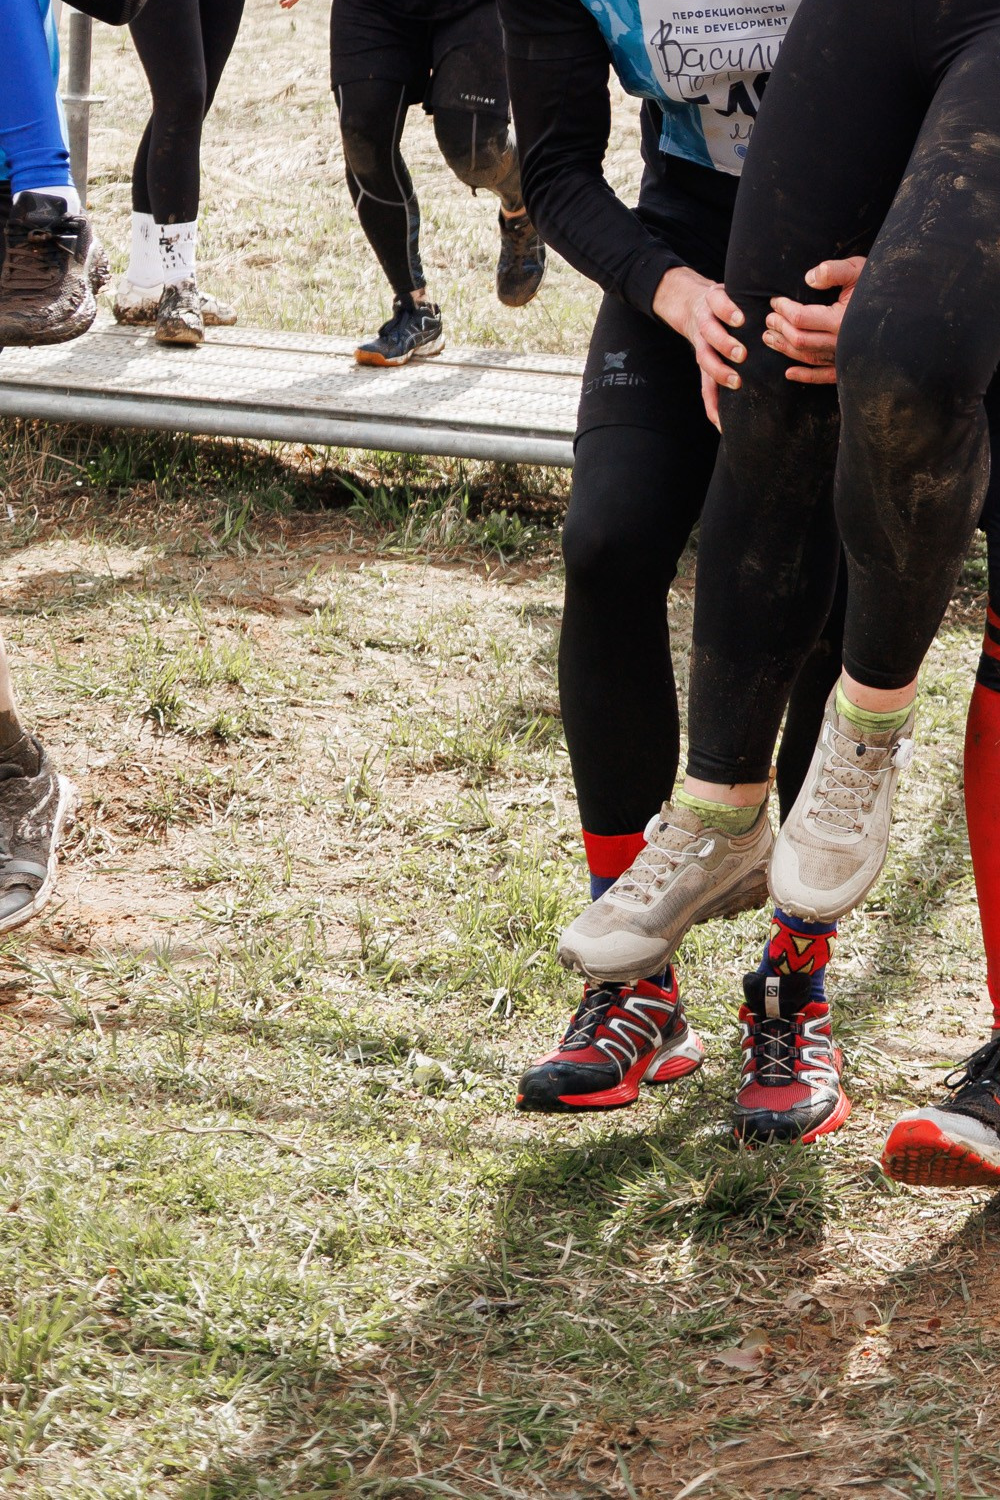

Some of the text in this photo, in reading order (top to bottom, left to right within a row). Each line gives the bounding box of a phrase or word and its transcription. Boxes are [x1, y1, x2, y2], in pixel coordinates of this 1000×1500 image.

[672, 4, 786, 20] ПЕРФЕКЦИОНИСТЫ
[675, 17, 788, 35] FINE DEVELOPMENT
